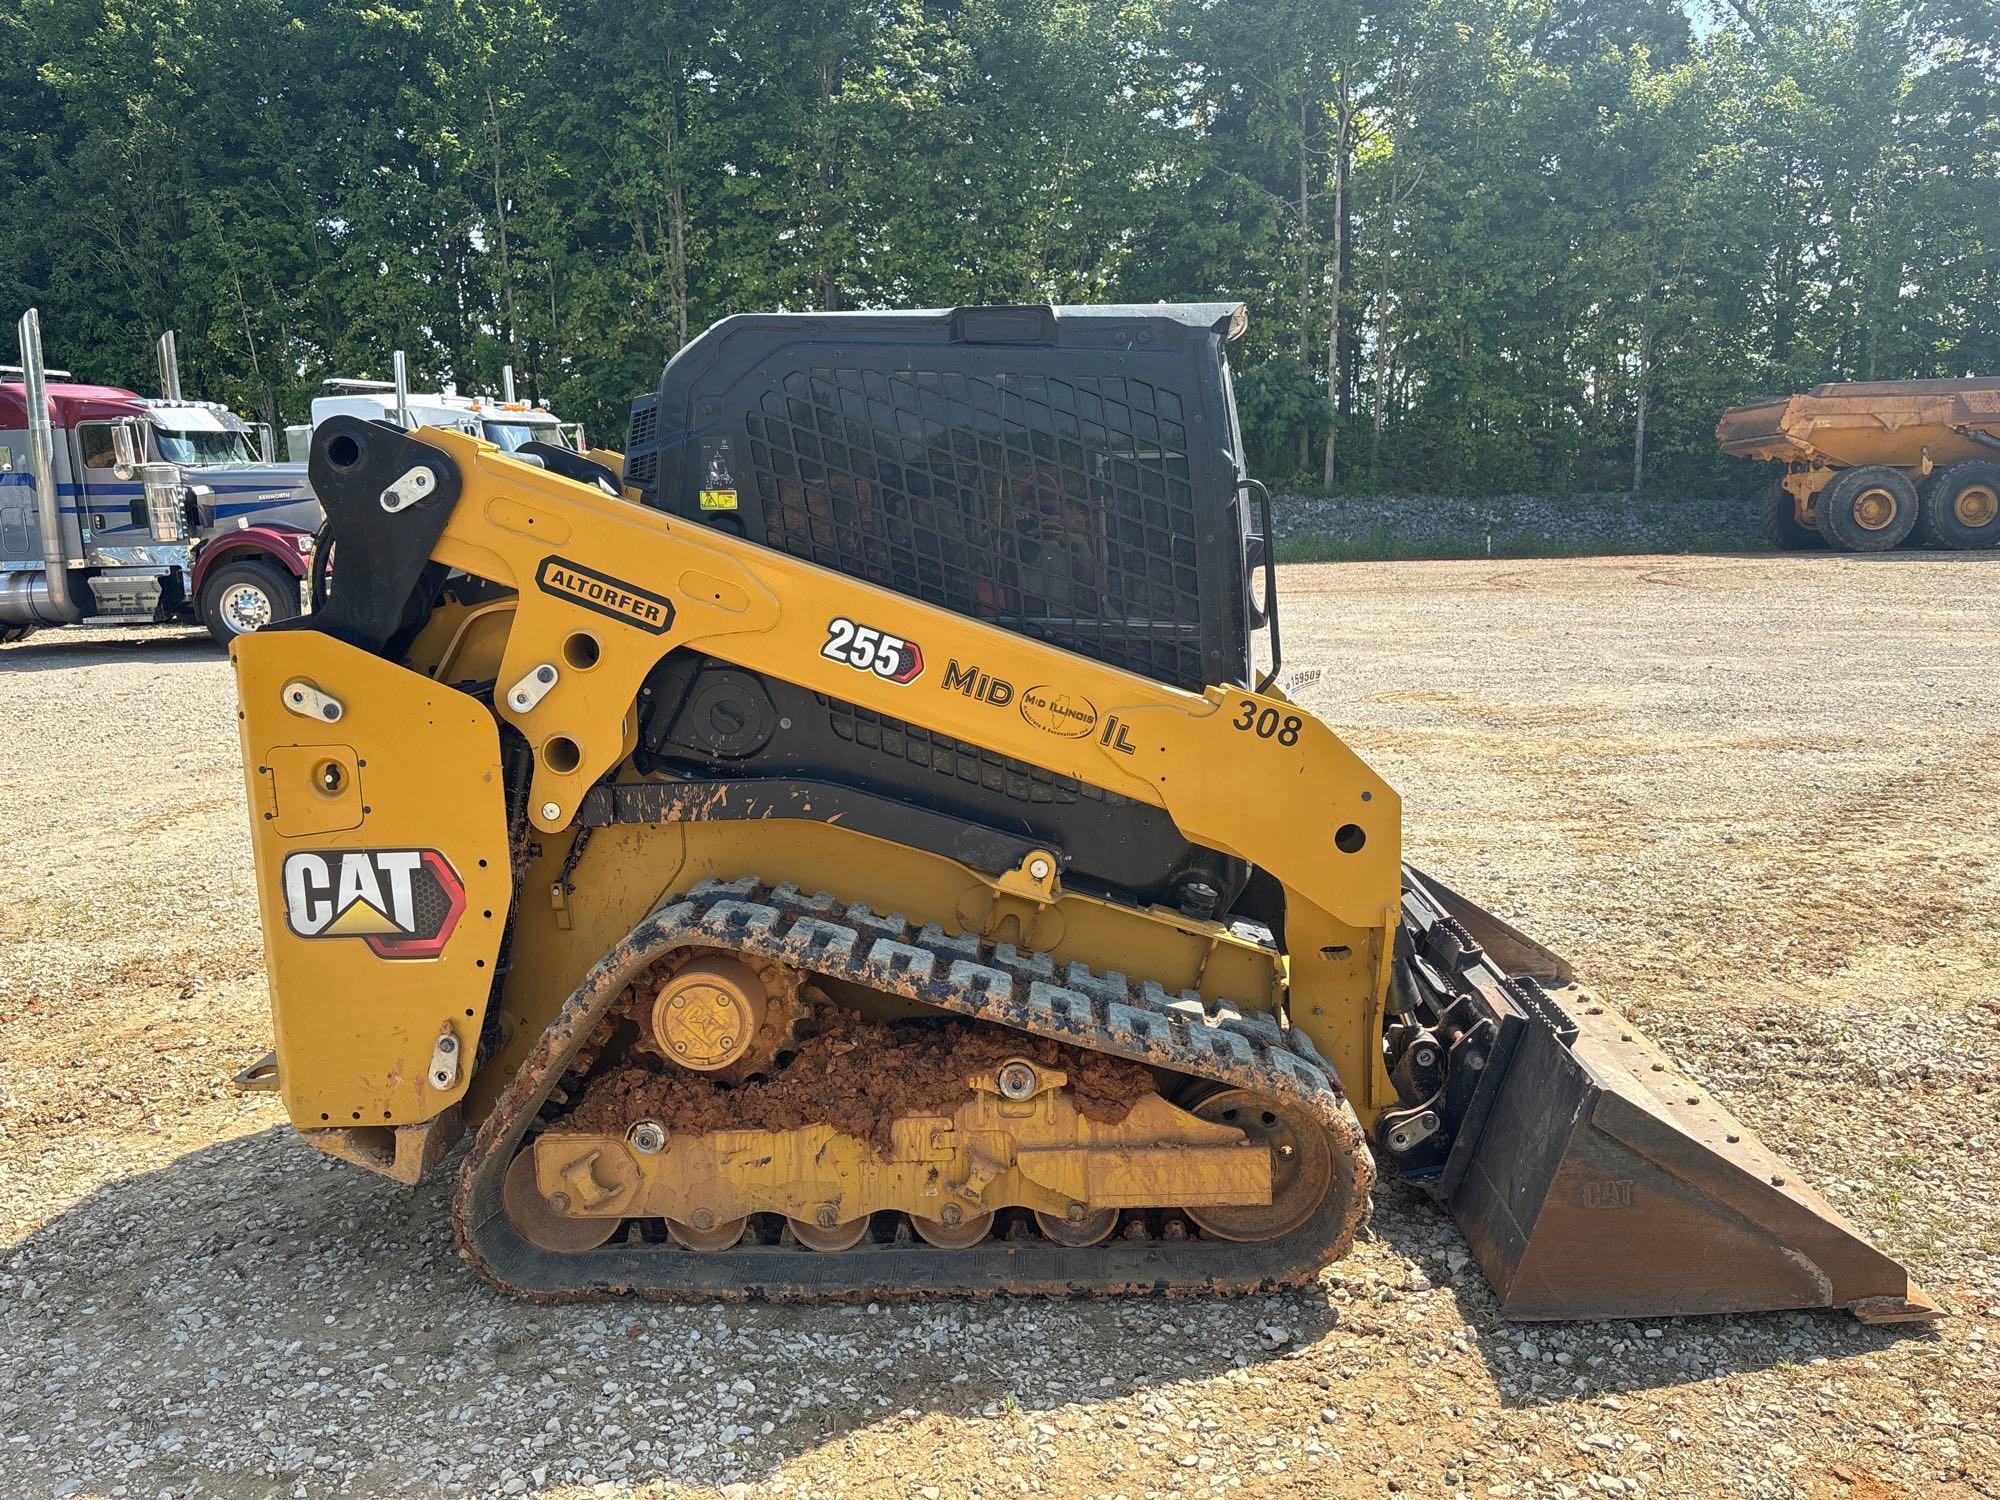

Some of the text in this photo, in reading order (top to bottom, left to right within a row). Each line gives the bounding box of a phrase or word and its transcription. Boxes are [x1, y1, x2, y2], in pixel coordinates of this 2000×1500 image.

[258, 492, 291, 501] KENWORTH
[550, 569, 661, 622] ALTORFER
[821, 619, 904, 676] 255
[941, 658, 1015, 708] MID
[1049, 701, 1095, 725] ILLINOIS
[1099, 714, 1137, 755] IL
[1232, 700, 1303, 747] 308
[284, 851, 421, 935] CAT
[1582, 1179, 1634, 1210] CAT
